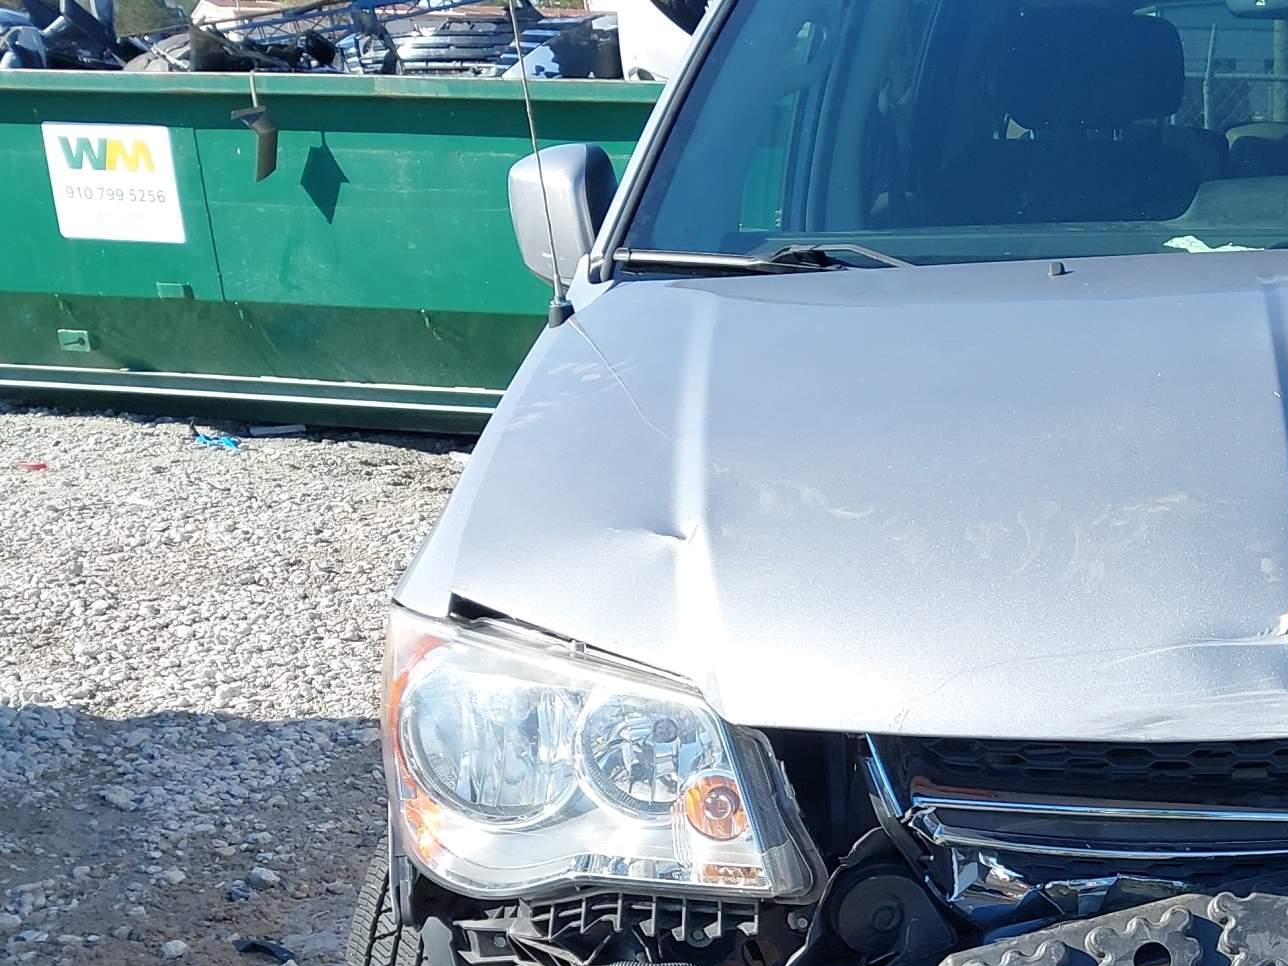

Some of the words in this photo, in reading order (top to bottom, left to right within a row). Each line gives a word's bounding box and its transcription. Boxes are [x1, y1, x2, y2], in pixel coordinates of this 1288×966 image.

[57, 136, 156, 173] WM
[65, 186, 93, 200] 910
[96, 187, 124, 202] 799
[128, 188, 167, 204] 5256
